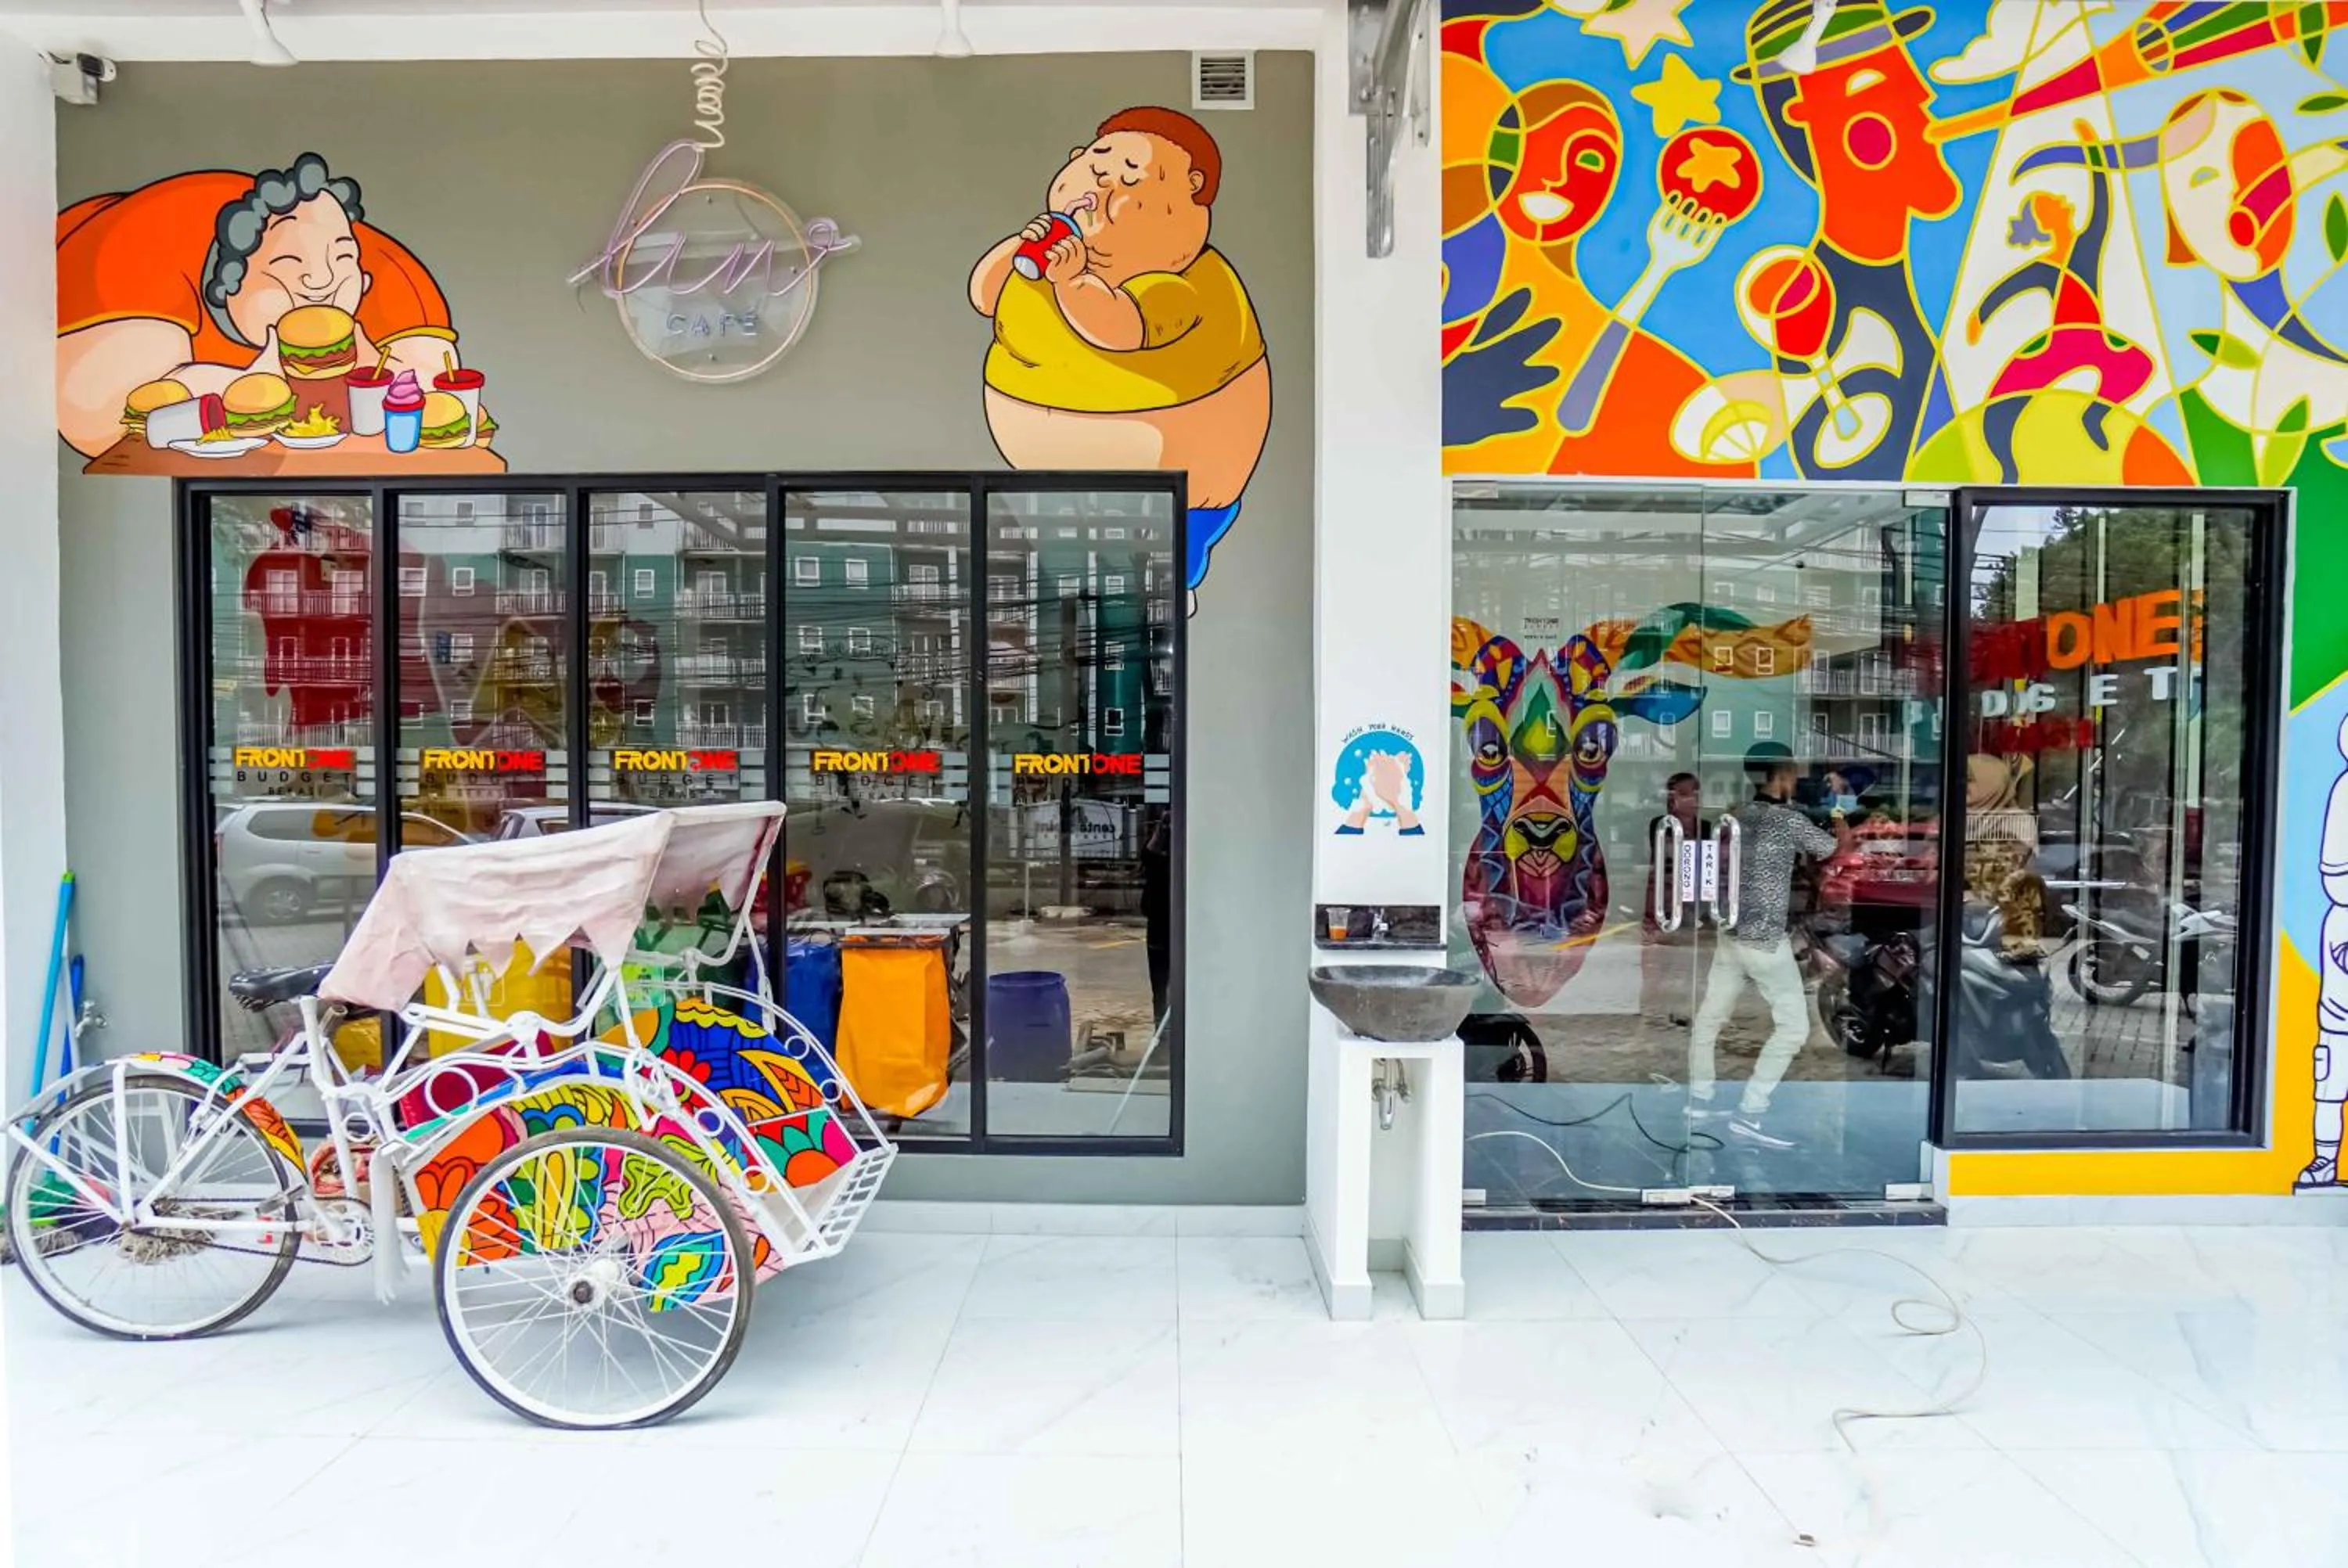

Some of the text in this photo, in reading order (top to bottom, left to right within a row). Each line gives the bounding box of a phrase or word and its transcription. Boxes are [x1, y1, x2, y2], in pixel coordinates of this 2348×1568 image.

[423, 750, 544, 771] FRONTONE
[814, 751, 940, 772] FRONTONE
[1014, 753, 1141, 775] FRONTONE
[237, 771, 351, 782] BUDGET
[815, 775, 940, 786] BDGET
